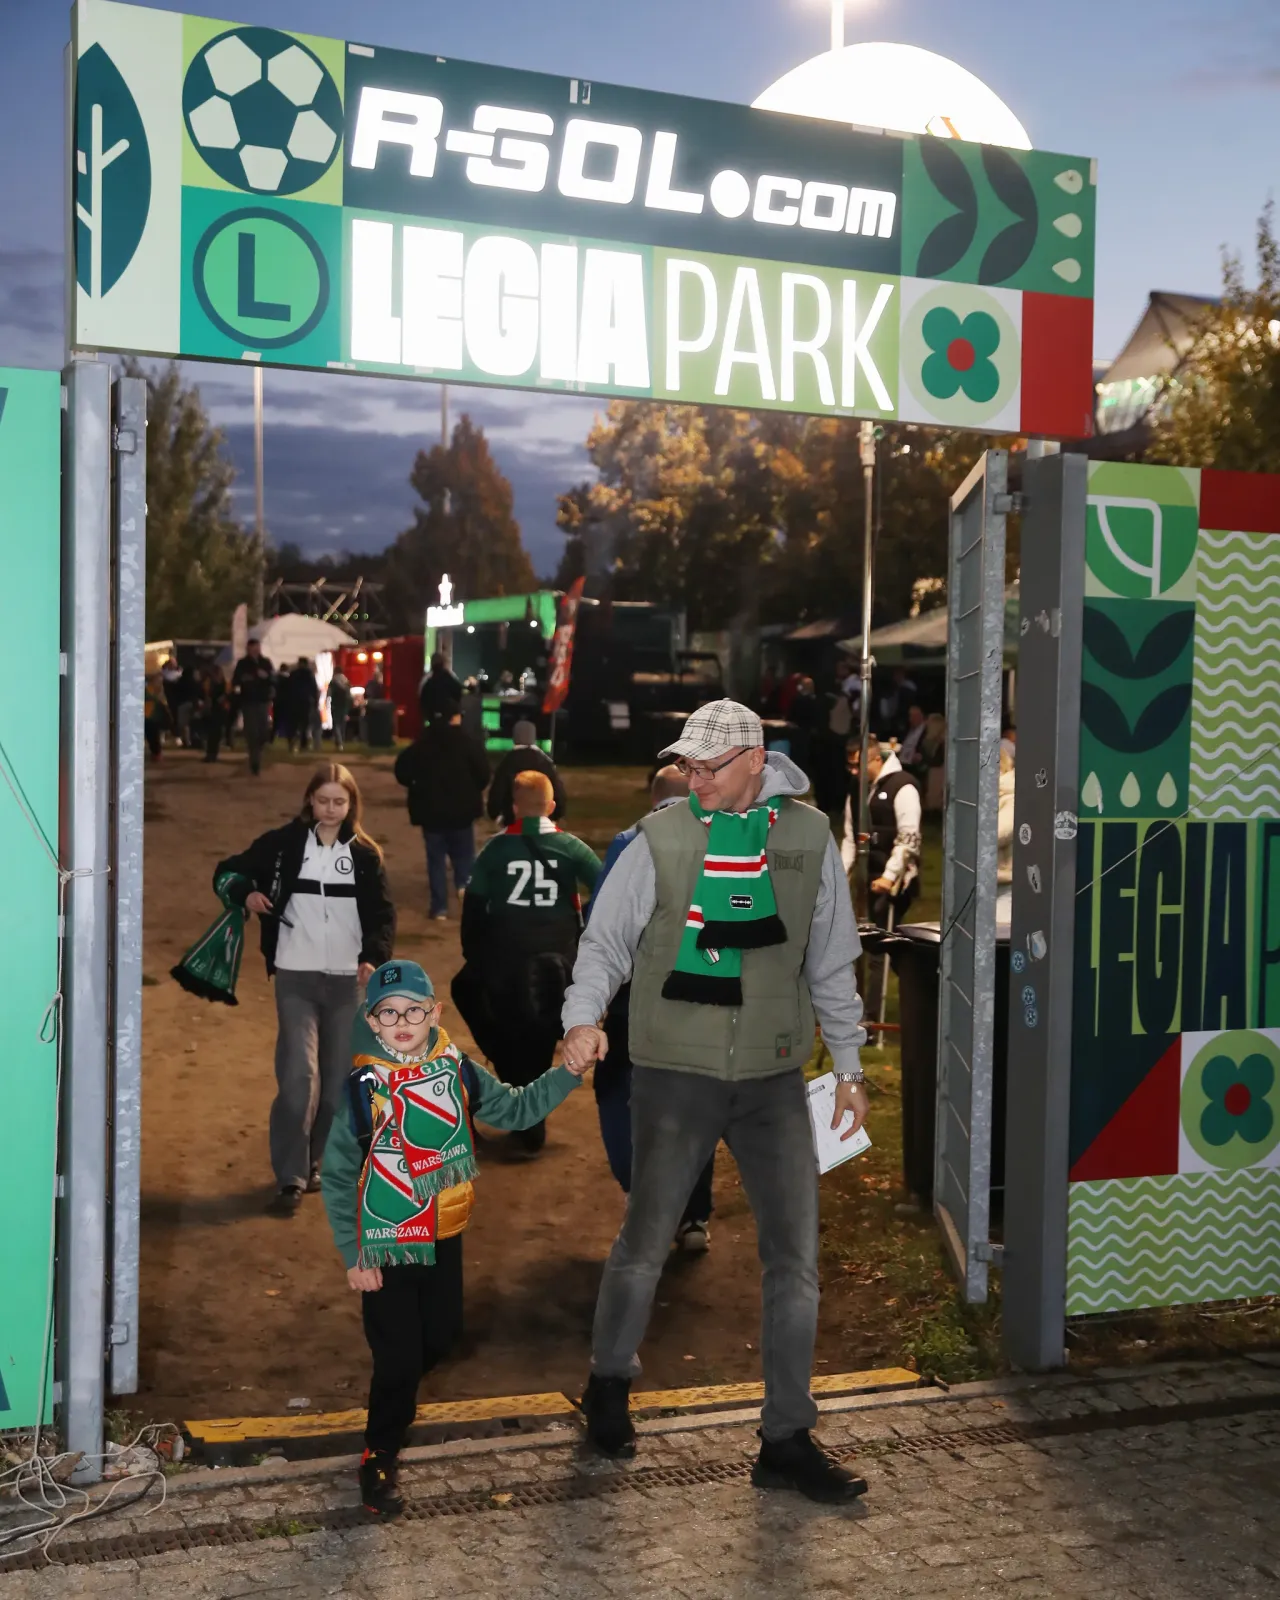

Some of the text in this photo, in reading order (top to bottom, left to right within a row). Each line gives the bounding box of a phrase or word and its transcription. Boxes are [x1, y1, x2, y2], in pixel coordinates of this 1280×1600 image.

[238, 231, 292, 323] L
[350, 218, 896, 412] LEGIA PARK
[506, 859, 559, 907] 25
[1073, 820, 1247, 1036] LEGIA
[393, 1057, 452, 1082] LEGIA
[412, 1142, 468, 1172] WARSZAWA
[365, 1226, 430, 1240] WARSZAWA
